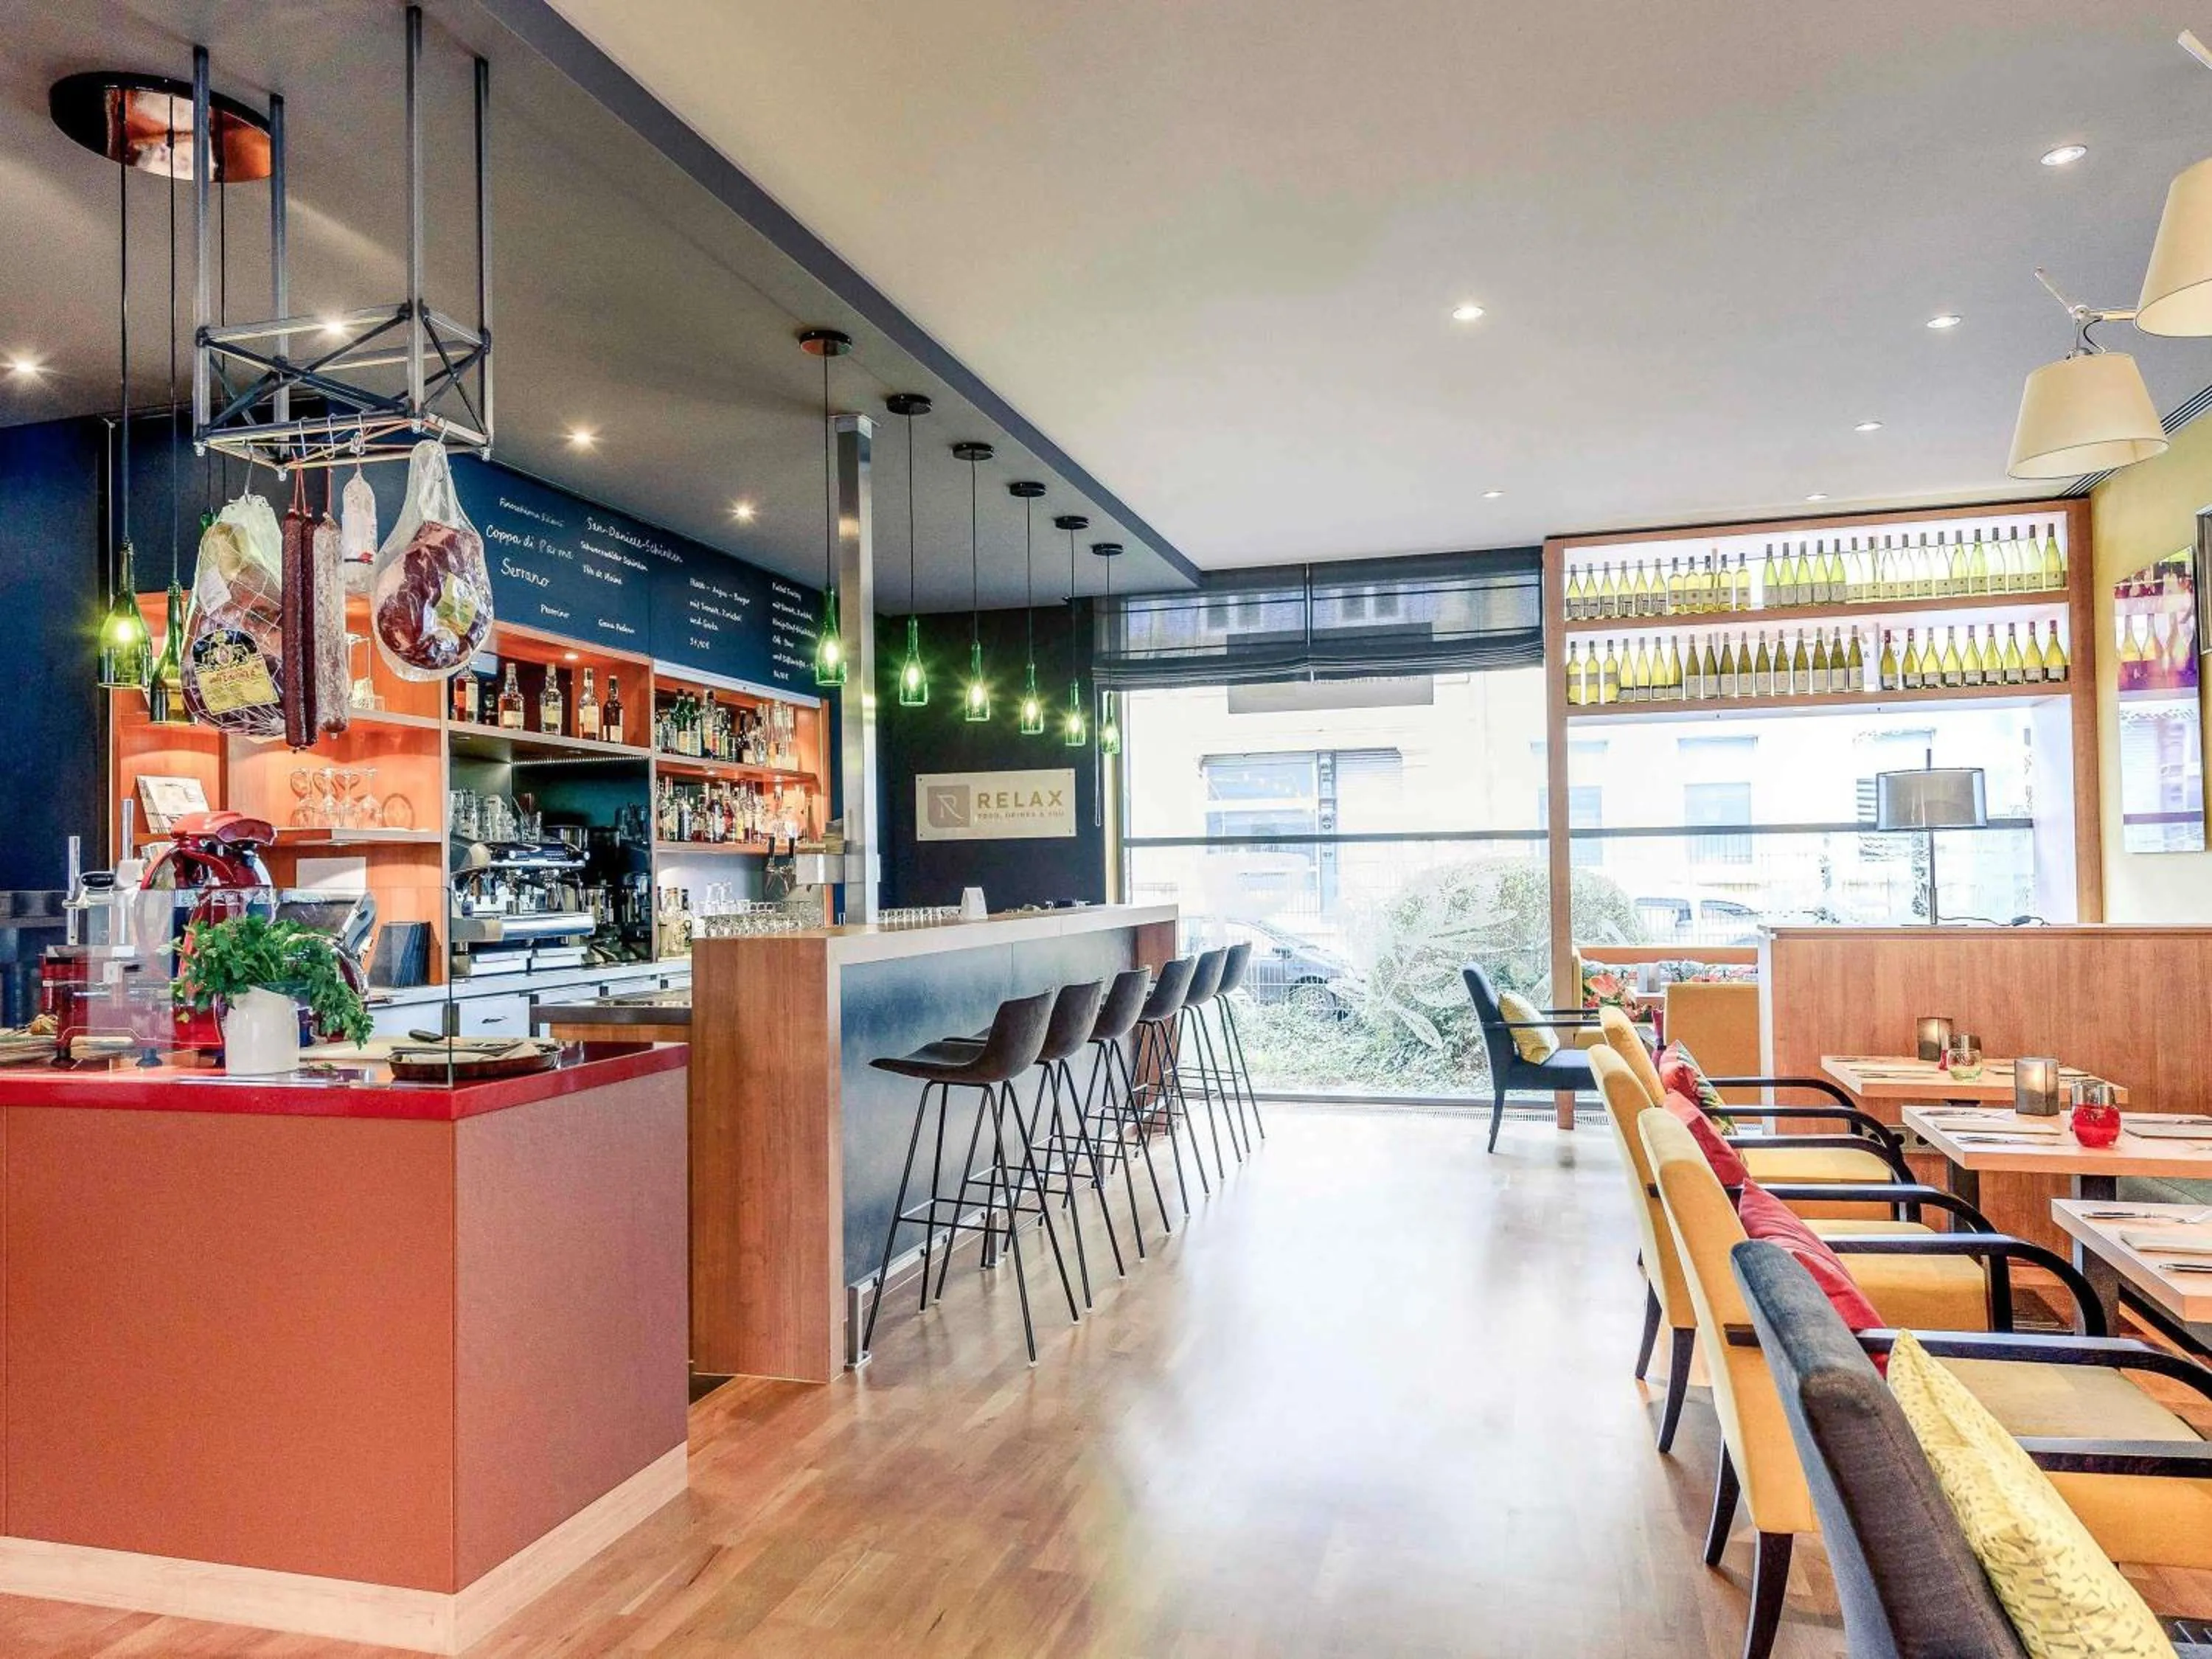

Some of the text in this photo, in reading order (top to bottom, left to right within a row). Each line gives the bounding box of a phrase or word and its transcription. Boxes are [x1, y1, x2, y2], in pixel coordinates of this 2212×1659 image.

[486, 524, 521, 546] Coppa
[539, 539, 574, 559] Parma
[501, 557, 550, 588] Serrano
[978, 790, 1063, 809] RELAX
